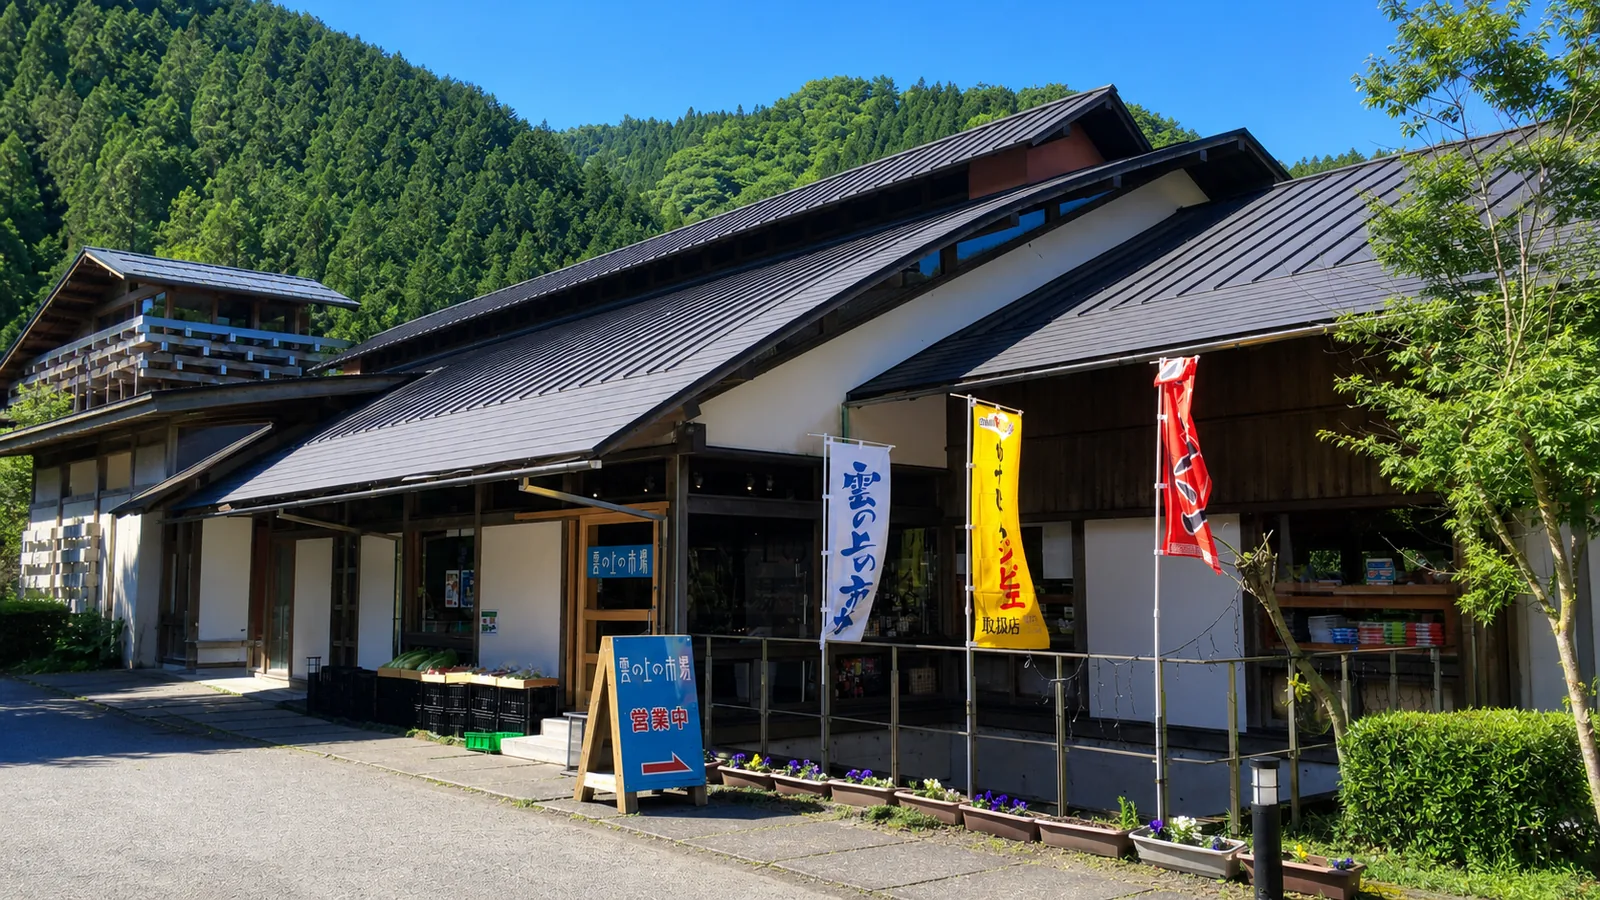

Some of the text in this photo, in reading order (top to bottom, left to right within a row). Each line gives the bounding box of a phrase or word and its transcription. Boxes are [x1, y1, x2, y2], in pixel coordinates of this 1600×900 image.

[592, 548, 648, 575] 雲の上の市場
[981, 616, 1020, 636] 取扱店
[618, 655, 692, 684] 雲の上の市場
[630, 705, 689, 733] 営業中
